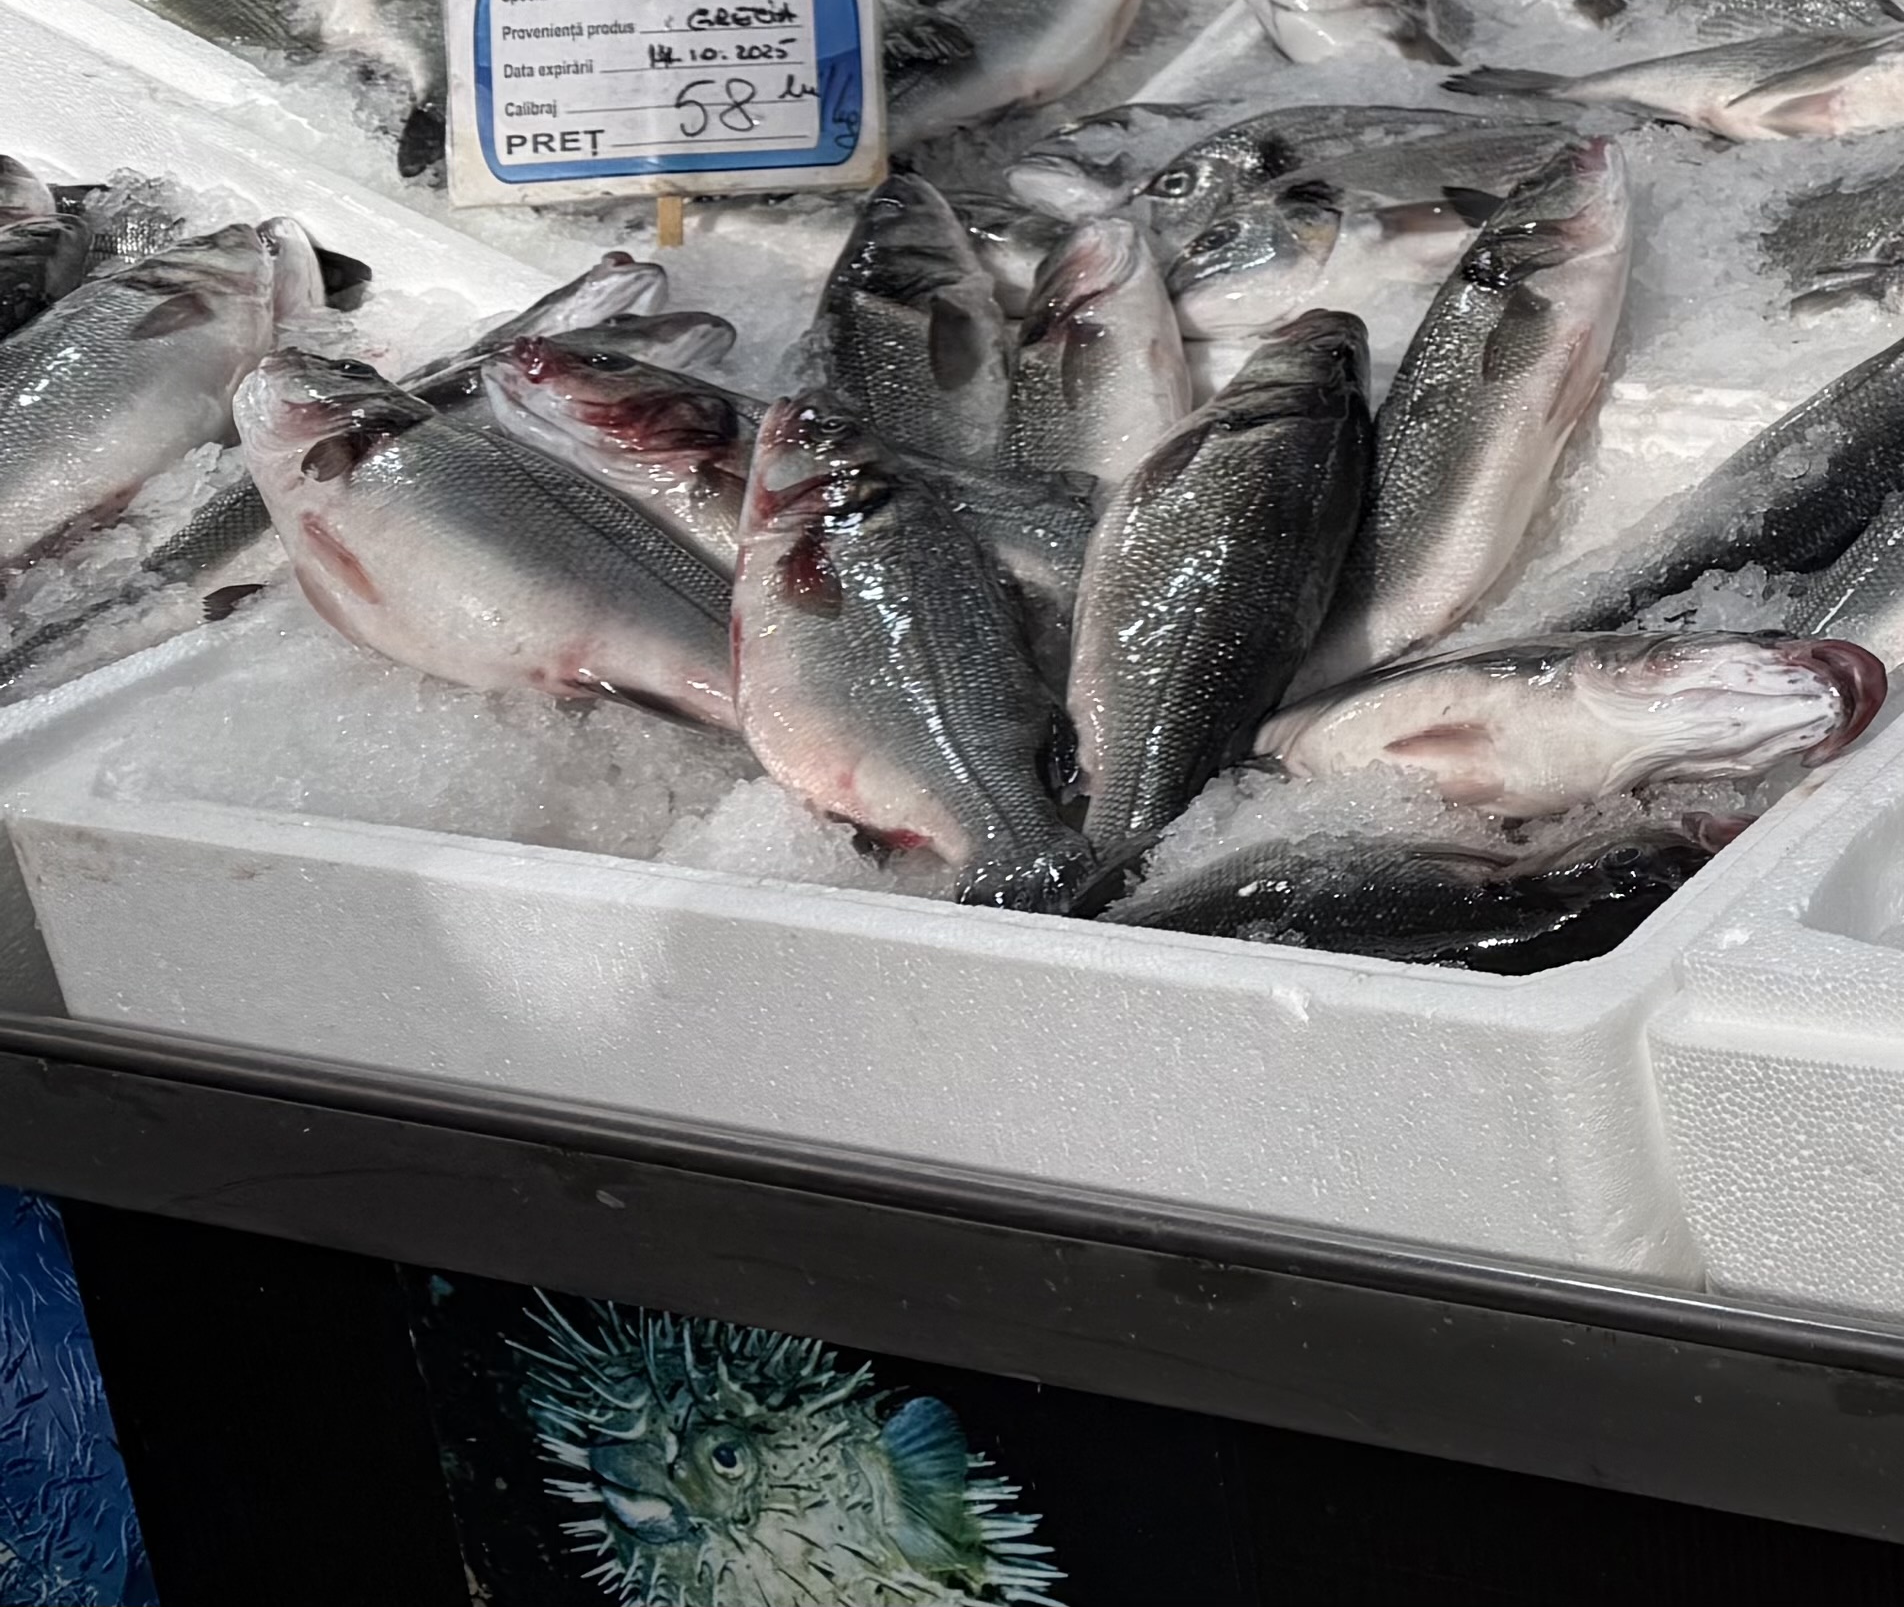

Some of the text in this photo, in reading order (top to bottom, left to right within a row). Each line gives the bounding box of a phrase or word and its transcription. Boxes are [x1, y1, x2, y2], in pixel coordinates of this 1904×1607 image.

[502, 23, 585, 42] Proveniență
[587, 20, 635, 39] produs
[503, 63, 535, 79] Data
[538, 59, 594, 80] expirării
[505, 98, 558, 119] Calibraj
[505, 129, 605, 156] PREȚ
[674, 77, 758, 137] 58
